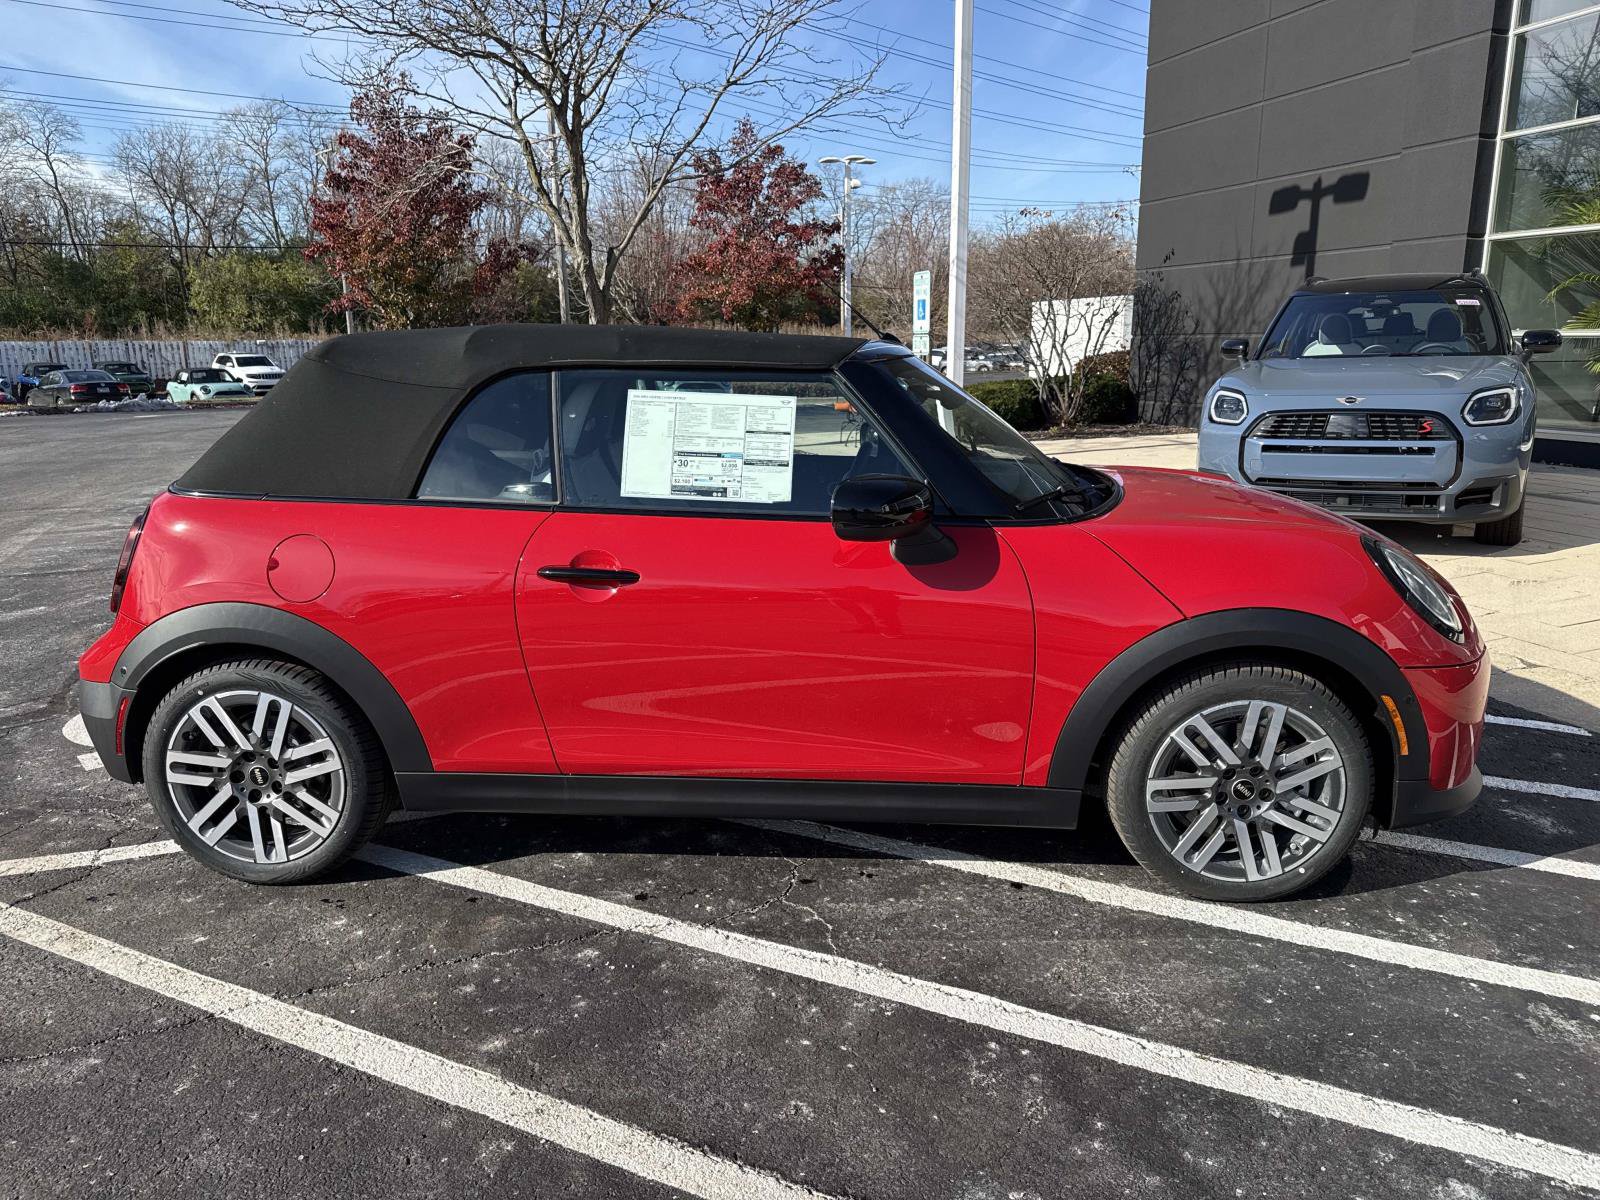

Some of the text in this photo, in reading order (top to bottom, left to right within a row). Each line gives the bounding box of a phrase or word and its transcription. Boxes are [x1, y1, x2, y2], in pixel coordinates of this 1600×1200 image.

[1418, 420, 1434, 433] S
[677, 459, 689, 467] 30
[254, 768, 264, 784] MINI
[1236, 783, 1252, 797] MINI
